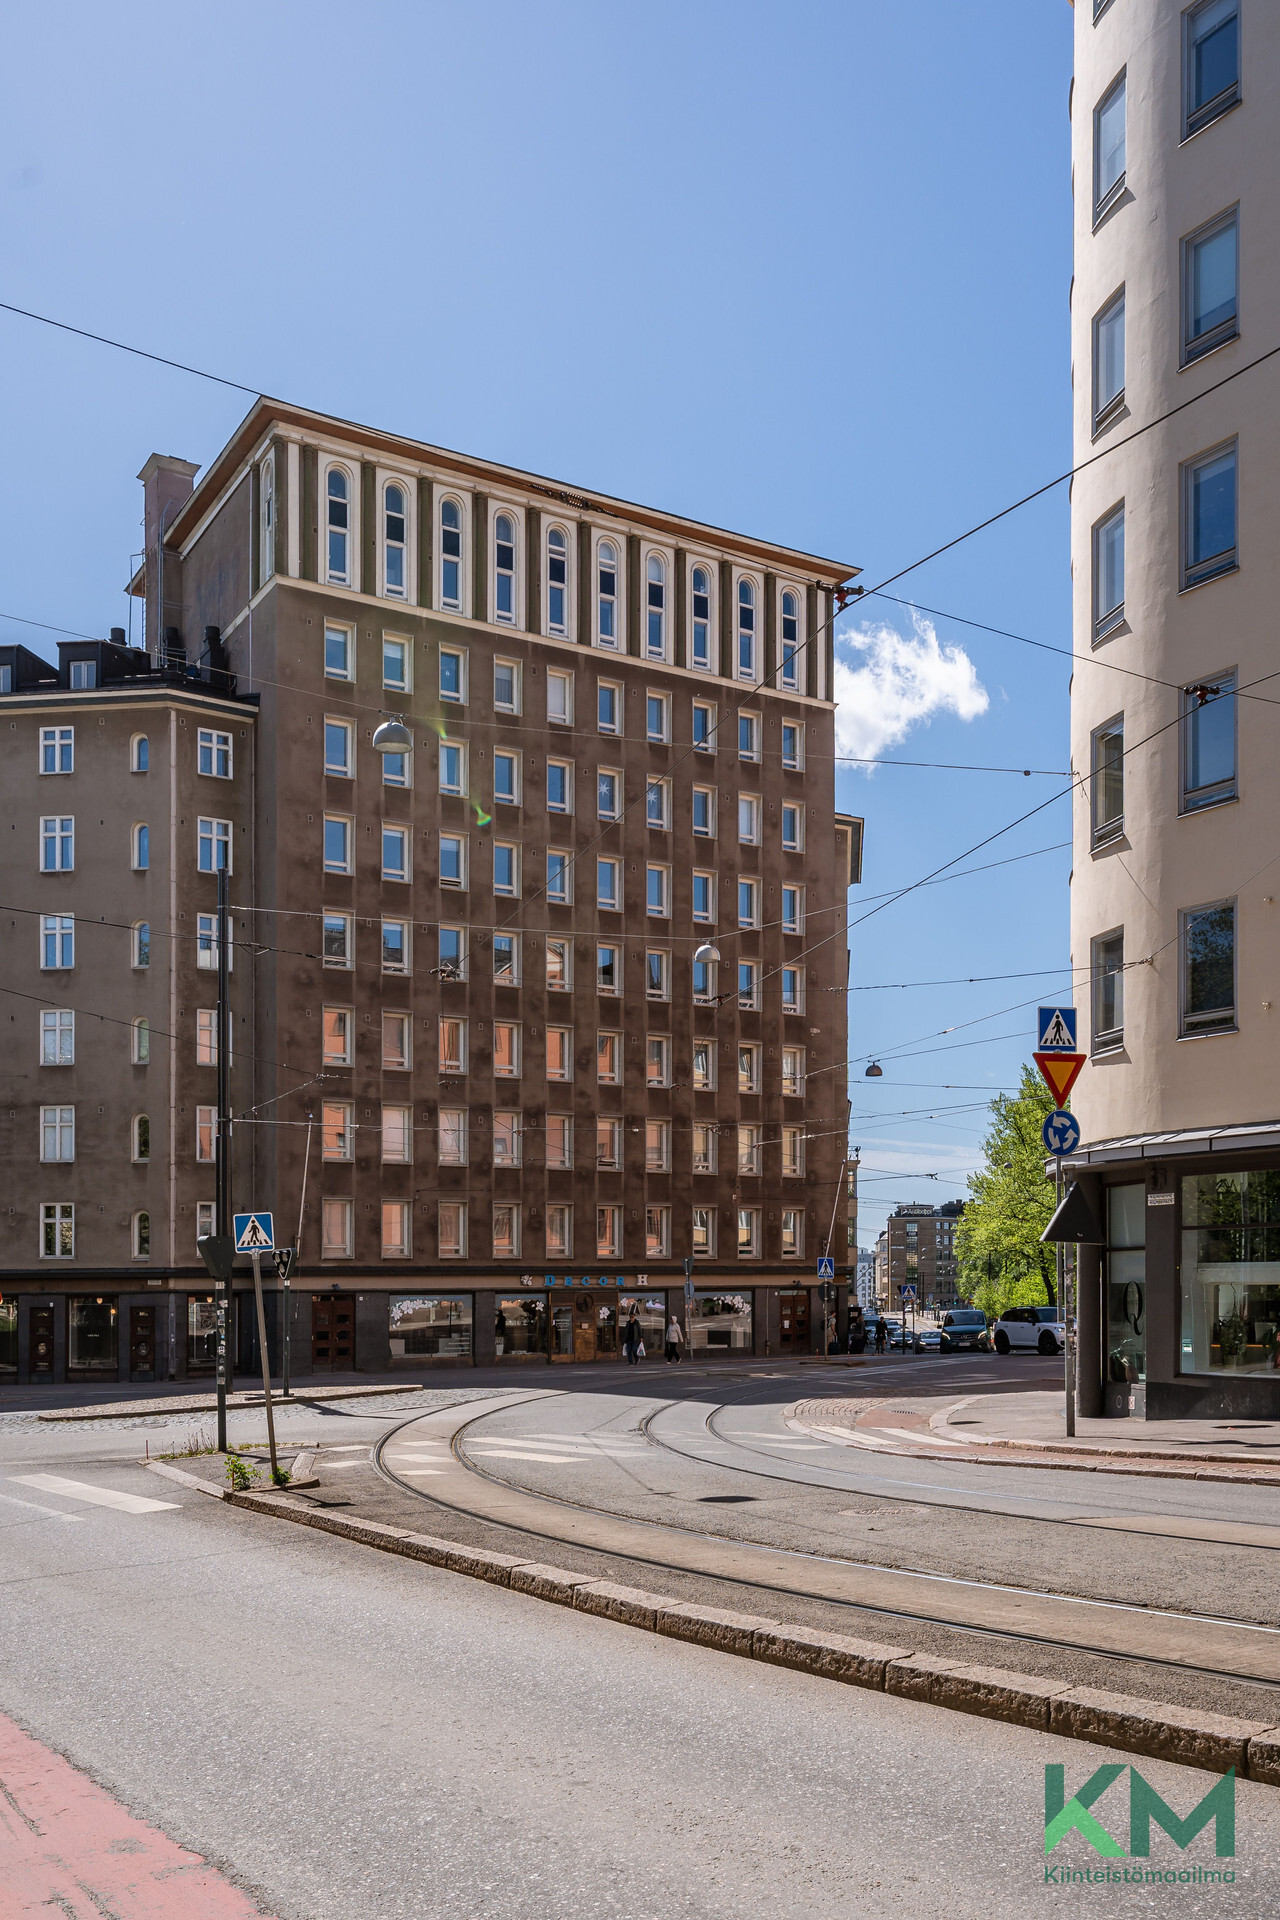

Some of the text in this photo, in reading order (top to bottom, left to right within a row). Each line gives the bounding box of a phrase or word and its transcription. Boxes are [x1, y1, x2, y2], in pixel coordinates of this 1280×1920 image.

[544, 1274, 648, 1286] DECOR H
[1122, 1281, 1143, 1336] Q
